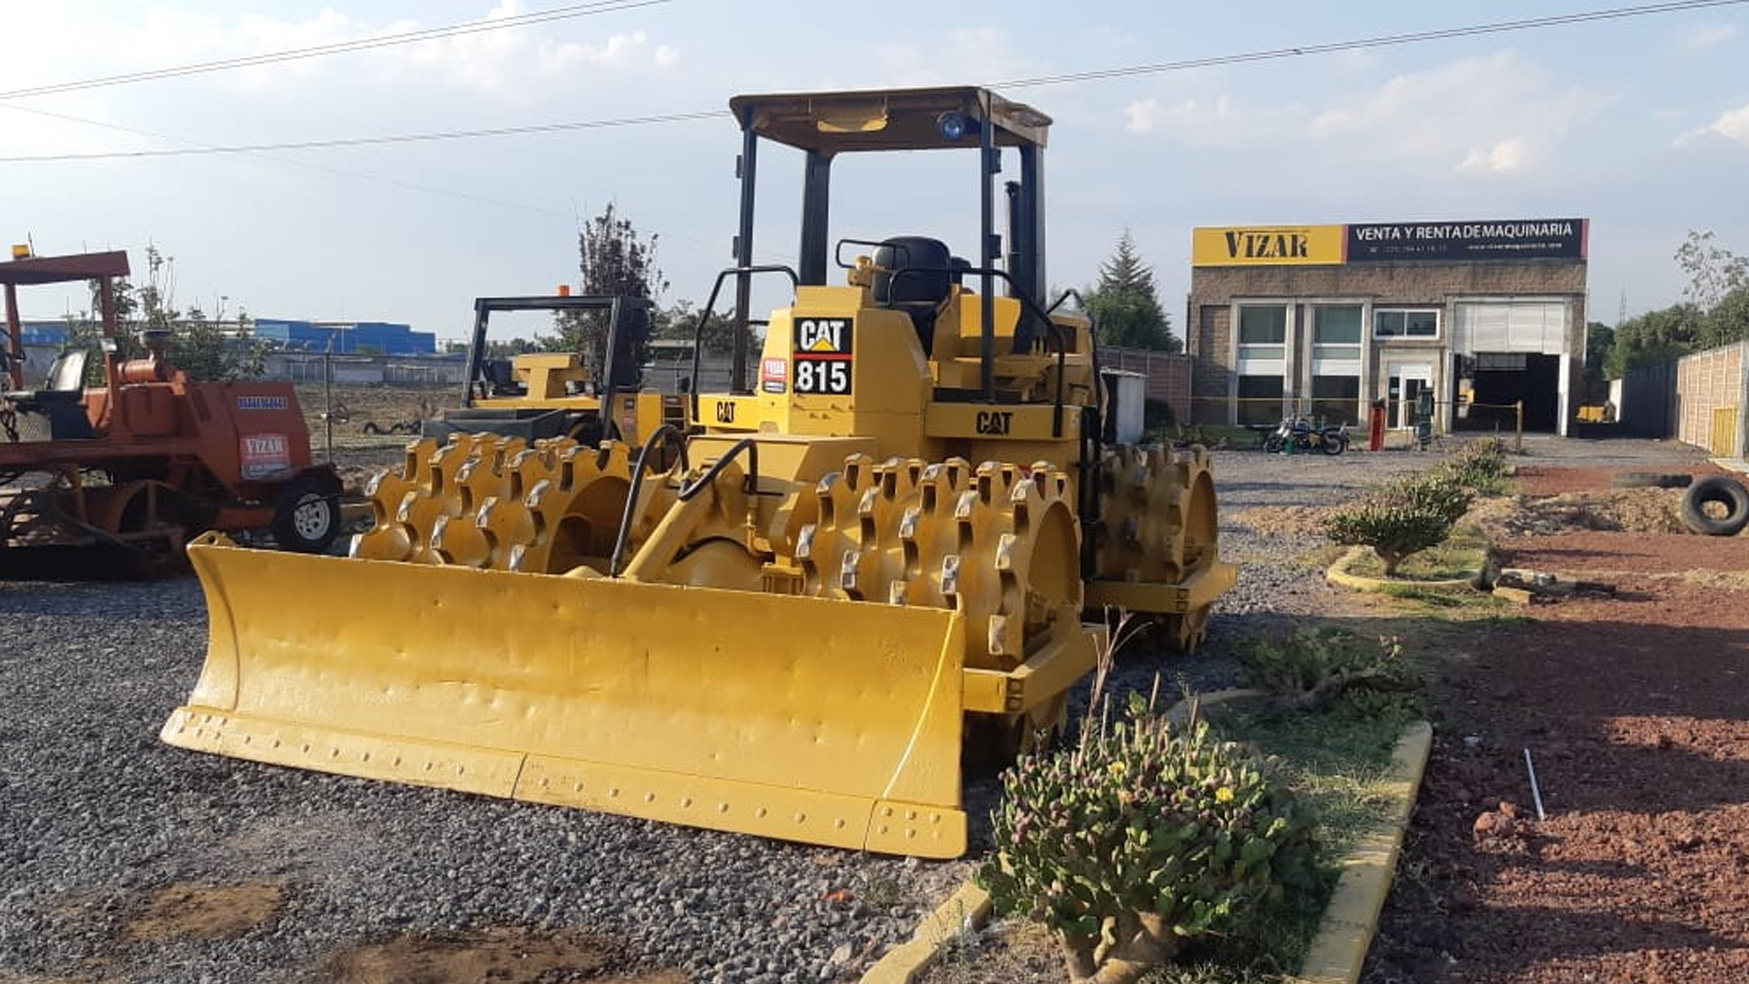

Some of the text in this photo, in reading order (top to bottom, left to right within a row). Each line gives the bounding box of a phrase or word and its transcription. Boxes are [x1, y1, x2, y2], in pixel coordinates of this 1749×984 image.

[1225, 231, 1308, 258] VIZAR
[1356, 223, 1573, 241] VENTA Y RENTA DE MAQUINARIA
[801, 320, 845, 351] CAT
[798, 361, 847, 391] 815
[717, 401, 735, 423] CAT
[976, 411, 1013, 434] CAT
